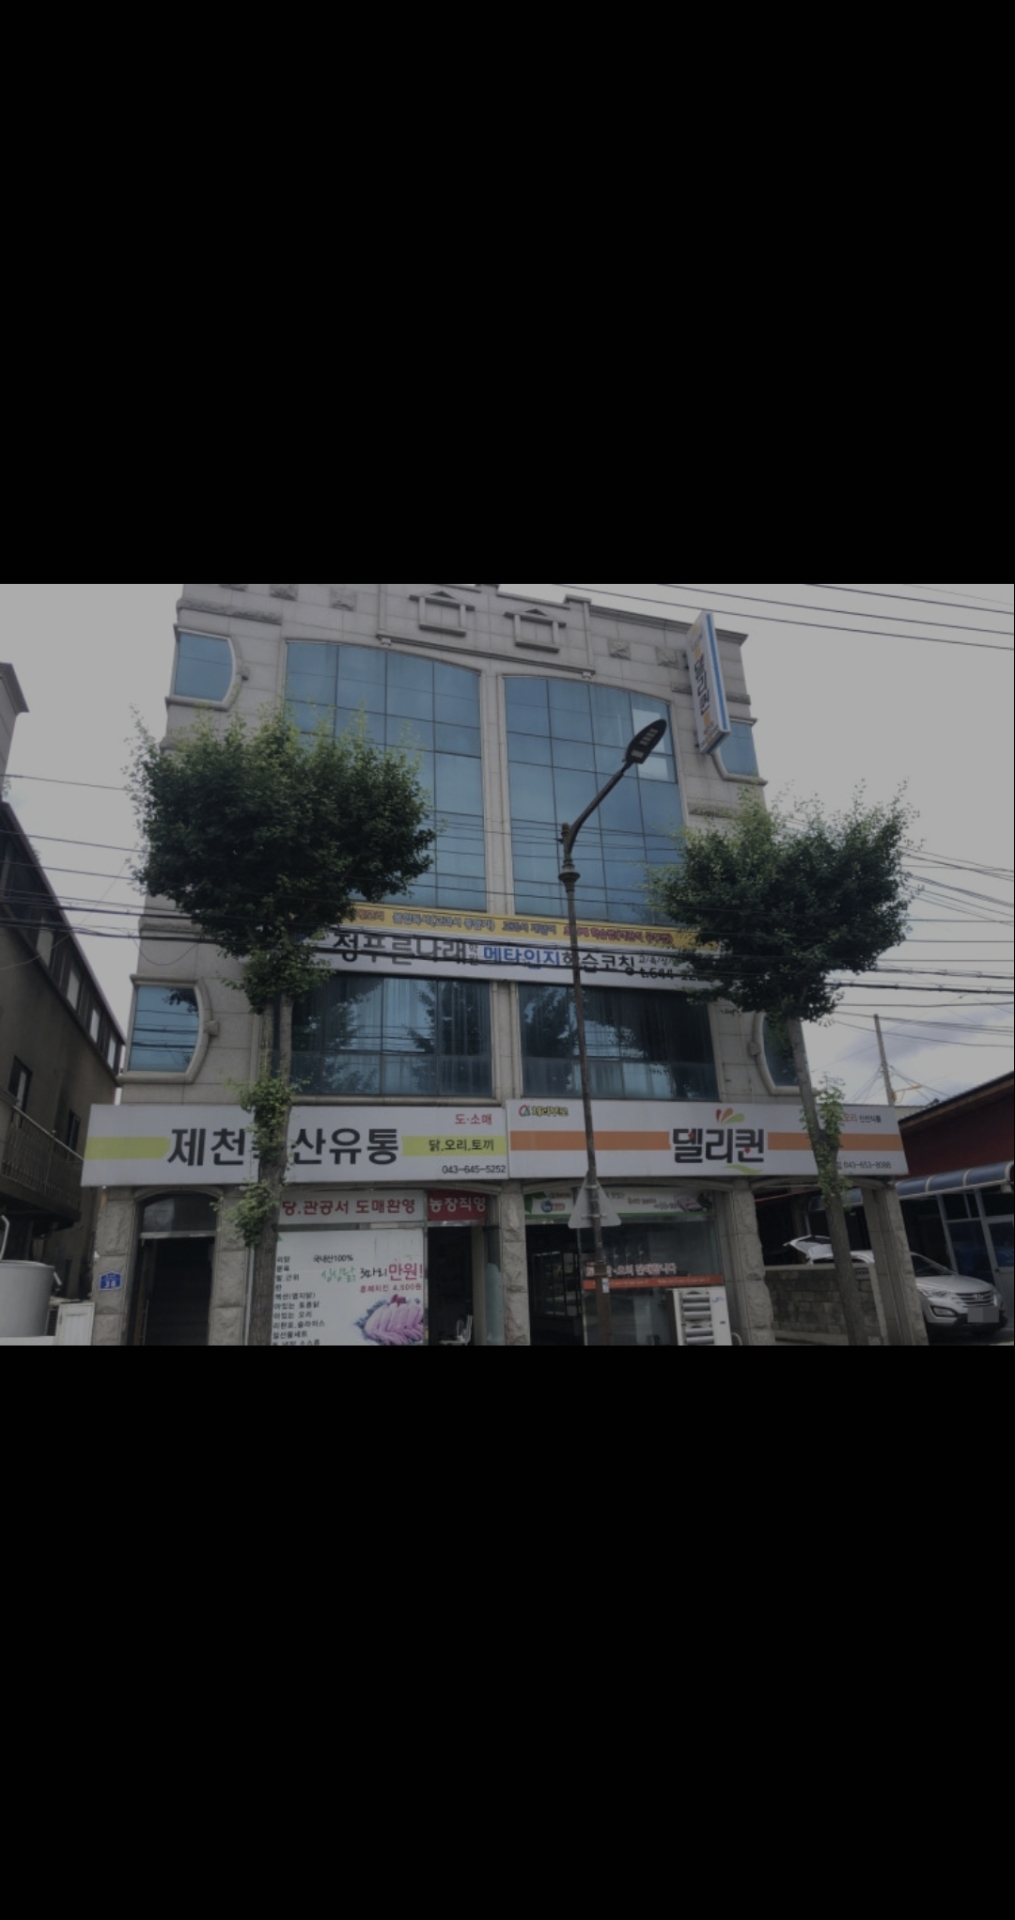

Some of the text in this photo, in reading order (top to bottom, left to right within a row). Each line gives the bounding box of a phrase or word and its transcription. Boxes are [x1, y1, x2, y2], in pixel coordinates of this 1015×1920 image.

[168, 1127, 399, 1166] 제천산유통
[672, 1128, 765, 1164] 델리퀸
[441, 1165, 506, 1175] 043-645-5252
[282, 1199, 416, 1217] 당.관공서 도매환영
[429, 1196, 487, 1213] 농장직영
[388, 1262, 423, 1281] 만원!
